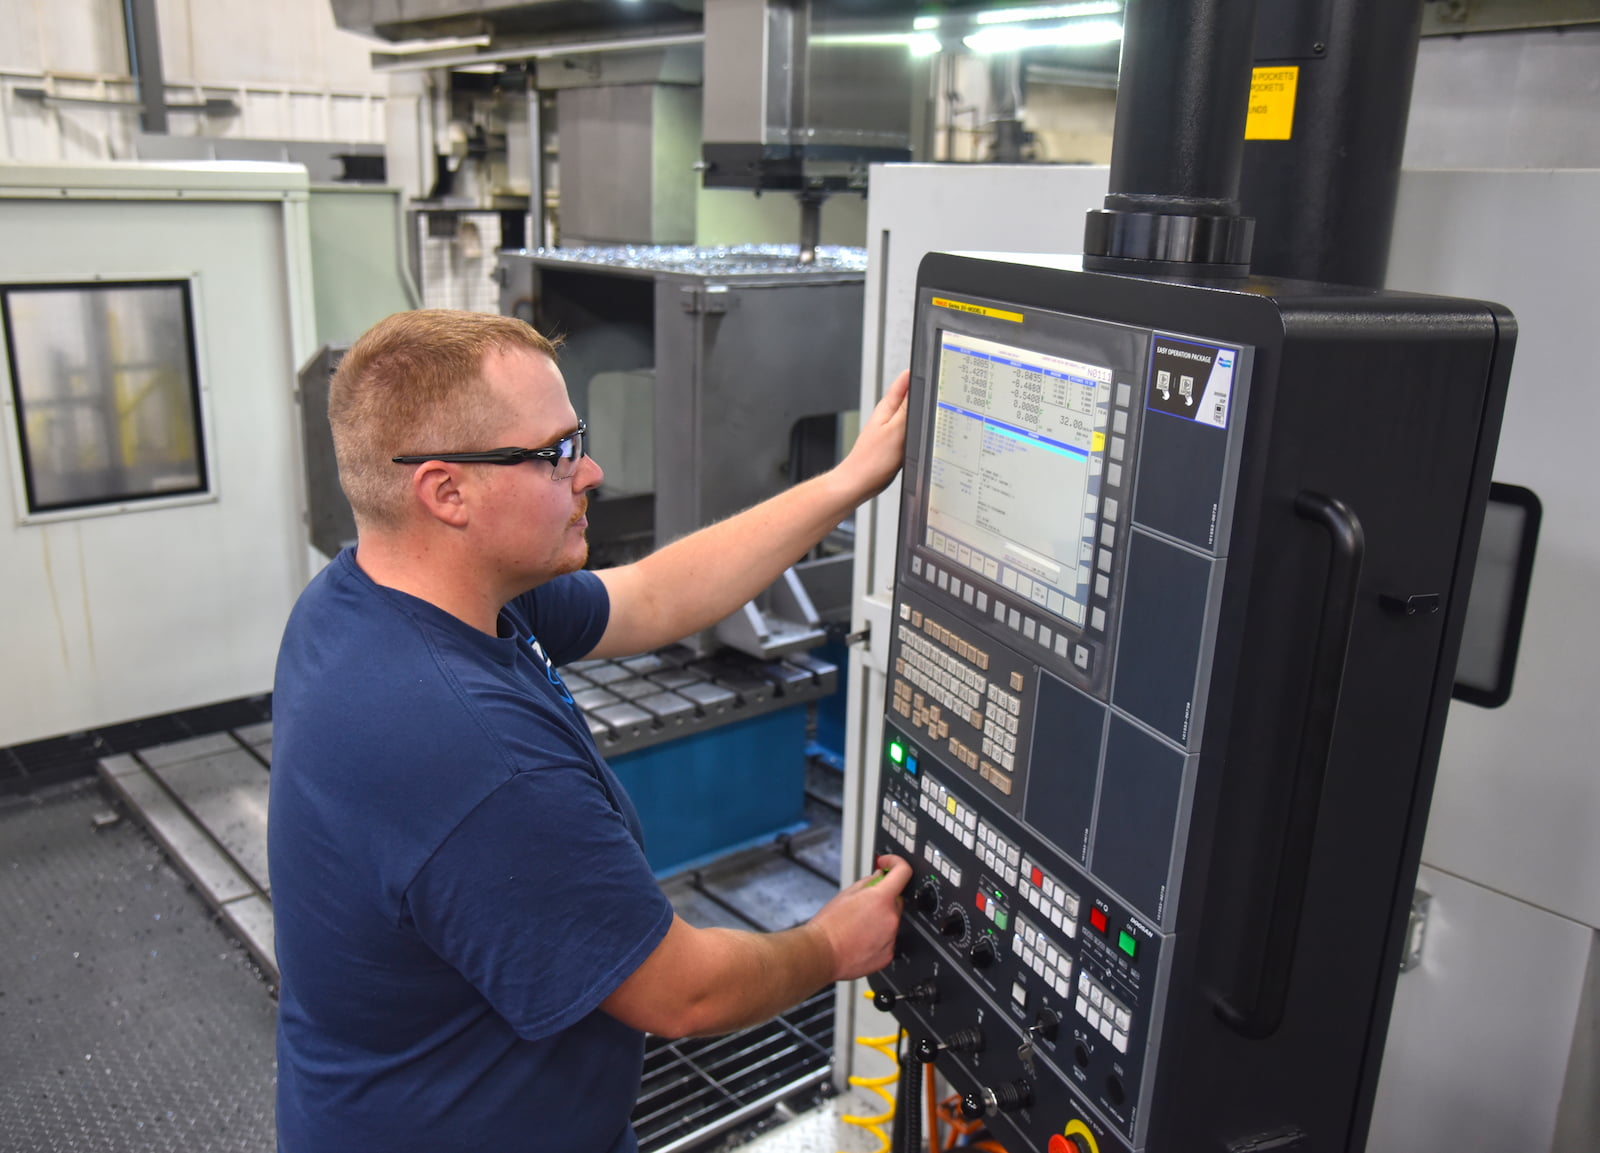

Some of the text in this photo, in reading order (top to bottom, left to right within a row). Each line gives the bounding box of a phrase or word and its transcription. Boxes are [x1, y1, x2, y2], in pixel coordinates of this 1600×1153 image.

[1156, 346, 1168, 355] EASY
[1168, 349, 1191, 359] OPERATION
[1191, 353, 1211, 363] PACKAGE
[1059, 415, 1083, 430] 32.00
[1129, 916, 1154, 938] DOOSAN
